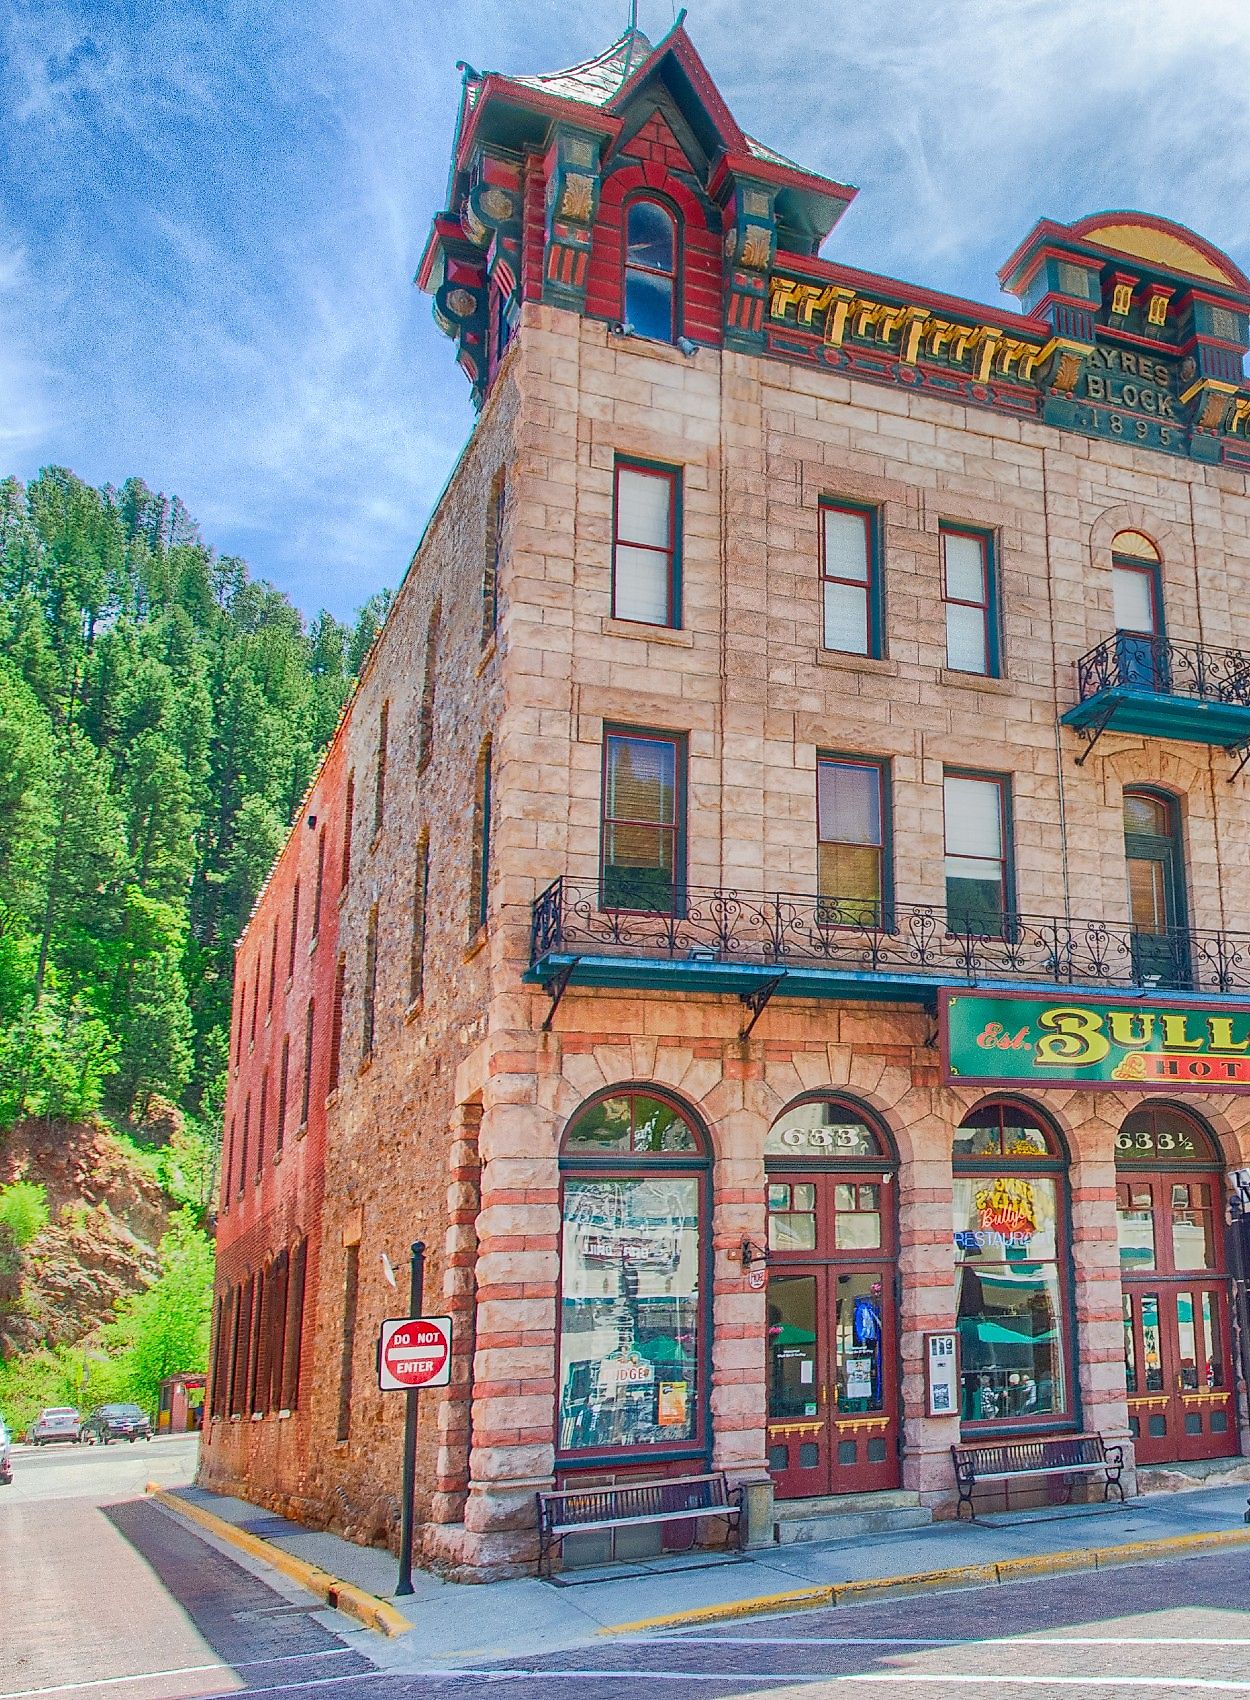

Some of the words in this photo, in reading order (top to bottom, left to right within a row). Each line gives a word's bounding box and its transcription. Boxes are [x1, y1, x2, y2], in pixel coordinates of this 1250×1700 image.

[1086, 348, 1170, 387] AYRES
[1086, 374, 1175, 418] BLOCK
[976, 1021, 1032, 1052] Est.
[781, 1127, 860, 1147] 633
[954, 1232, 1033, 1247] RESTAURA
[393, 1334, 410, 1345] DO
[417, 1332, 440, 1344] NOT
[397, 1361, 433, 1373] ENTER
